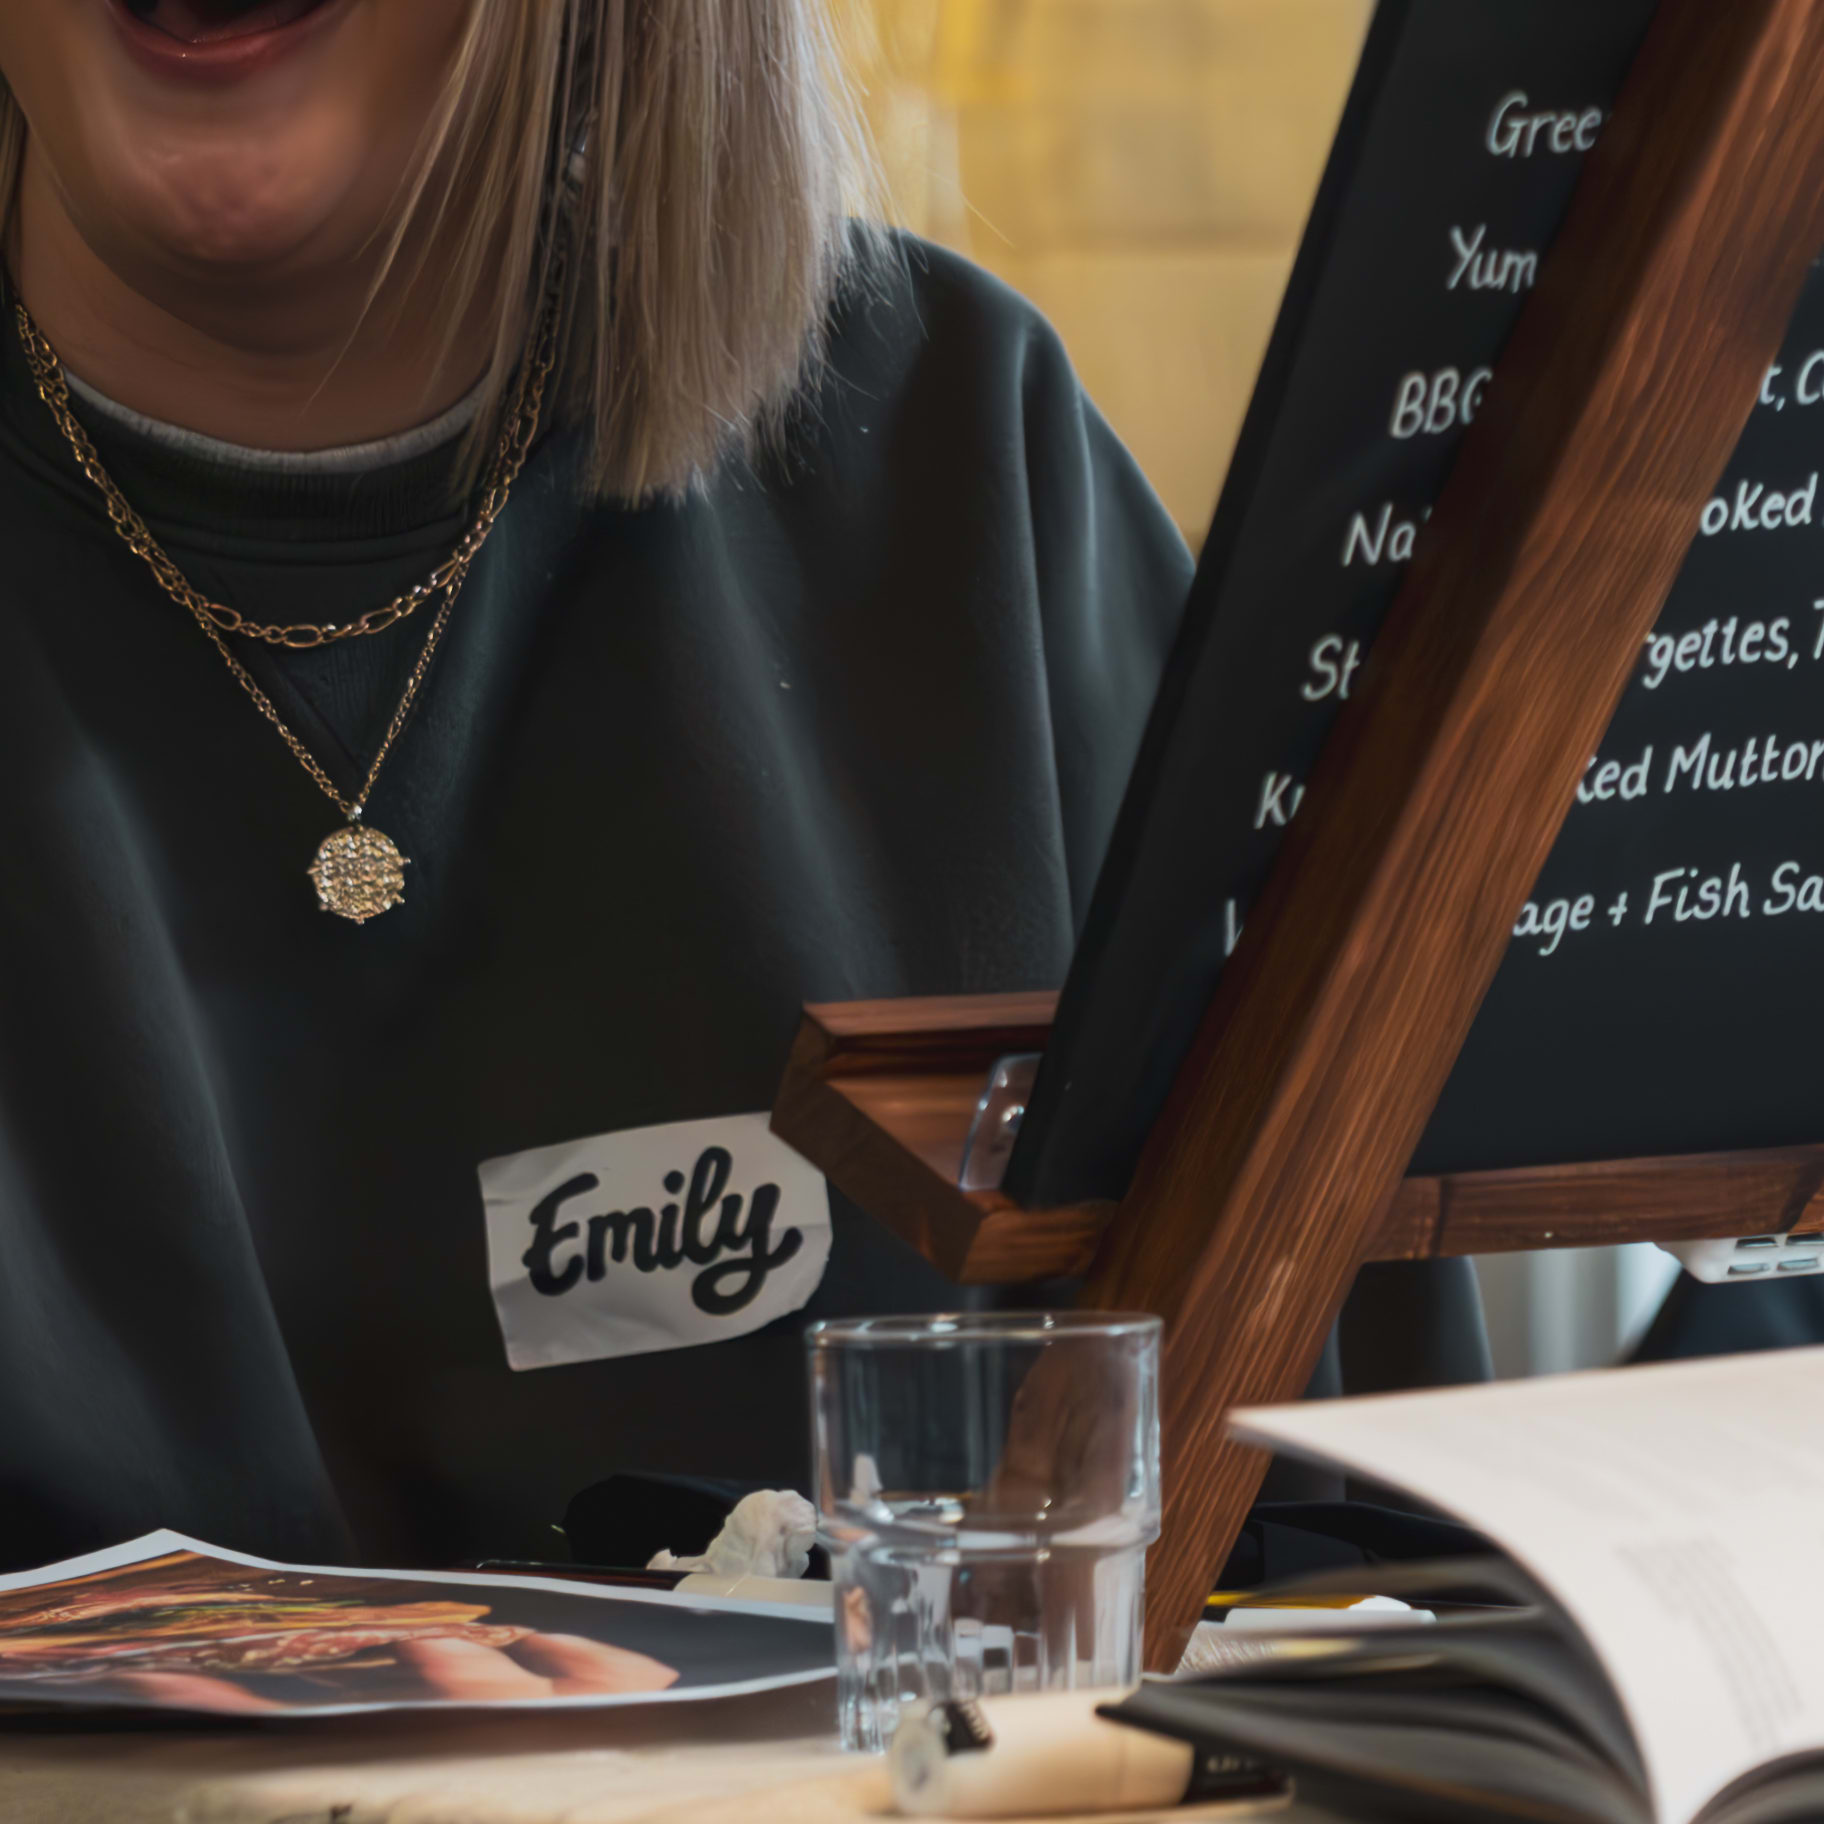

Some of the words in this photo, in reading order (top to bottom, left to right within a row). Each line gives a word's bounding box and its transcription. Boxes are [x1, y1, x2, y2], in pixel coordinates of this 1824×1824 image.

[1486, 92, 1606, 158] Gree
[1343, 503, 1431, 566] Na
[1642, 616, 1799, 690] gettes,
[1644, 862, 1751, 925] Fish
[521, 1145, 804, 1316] Emily
